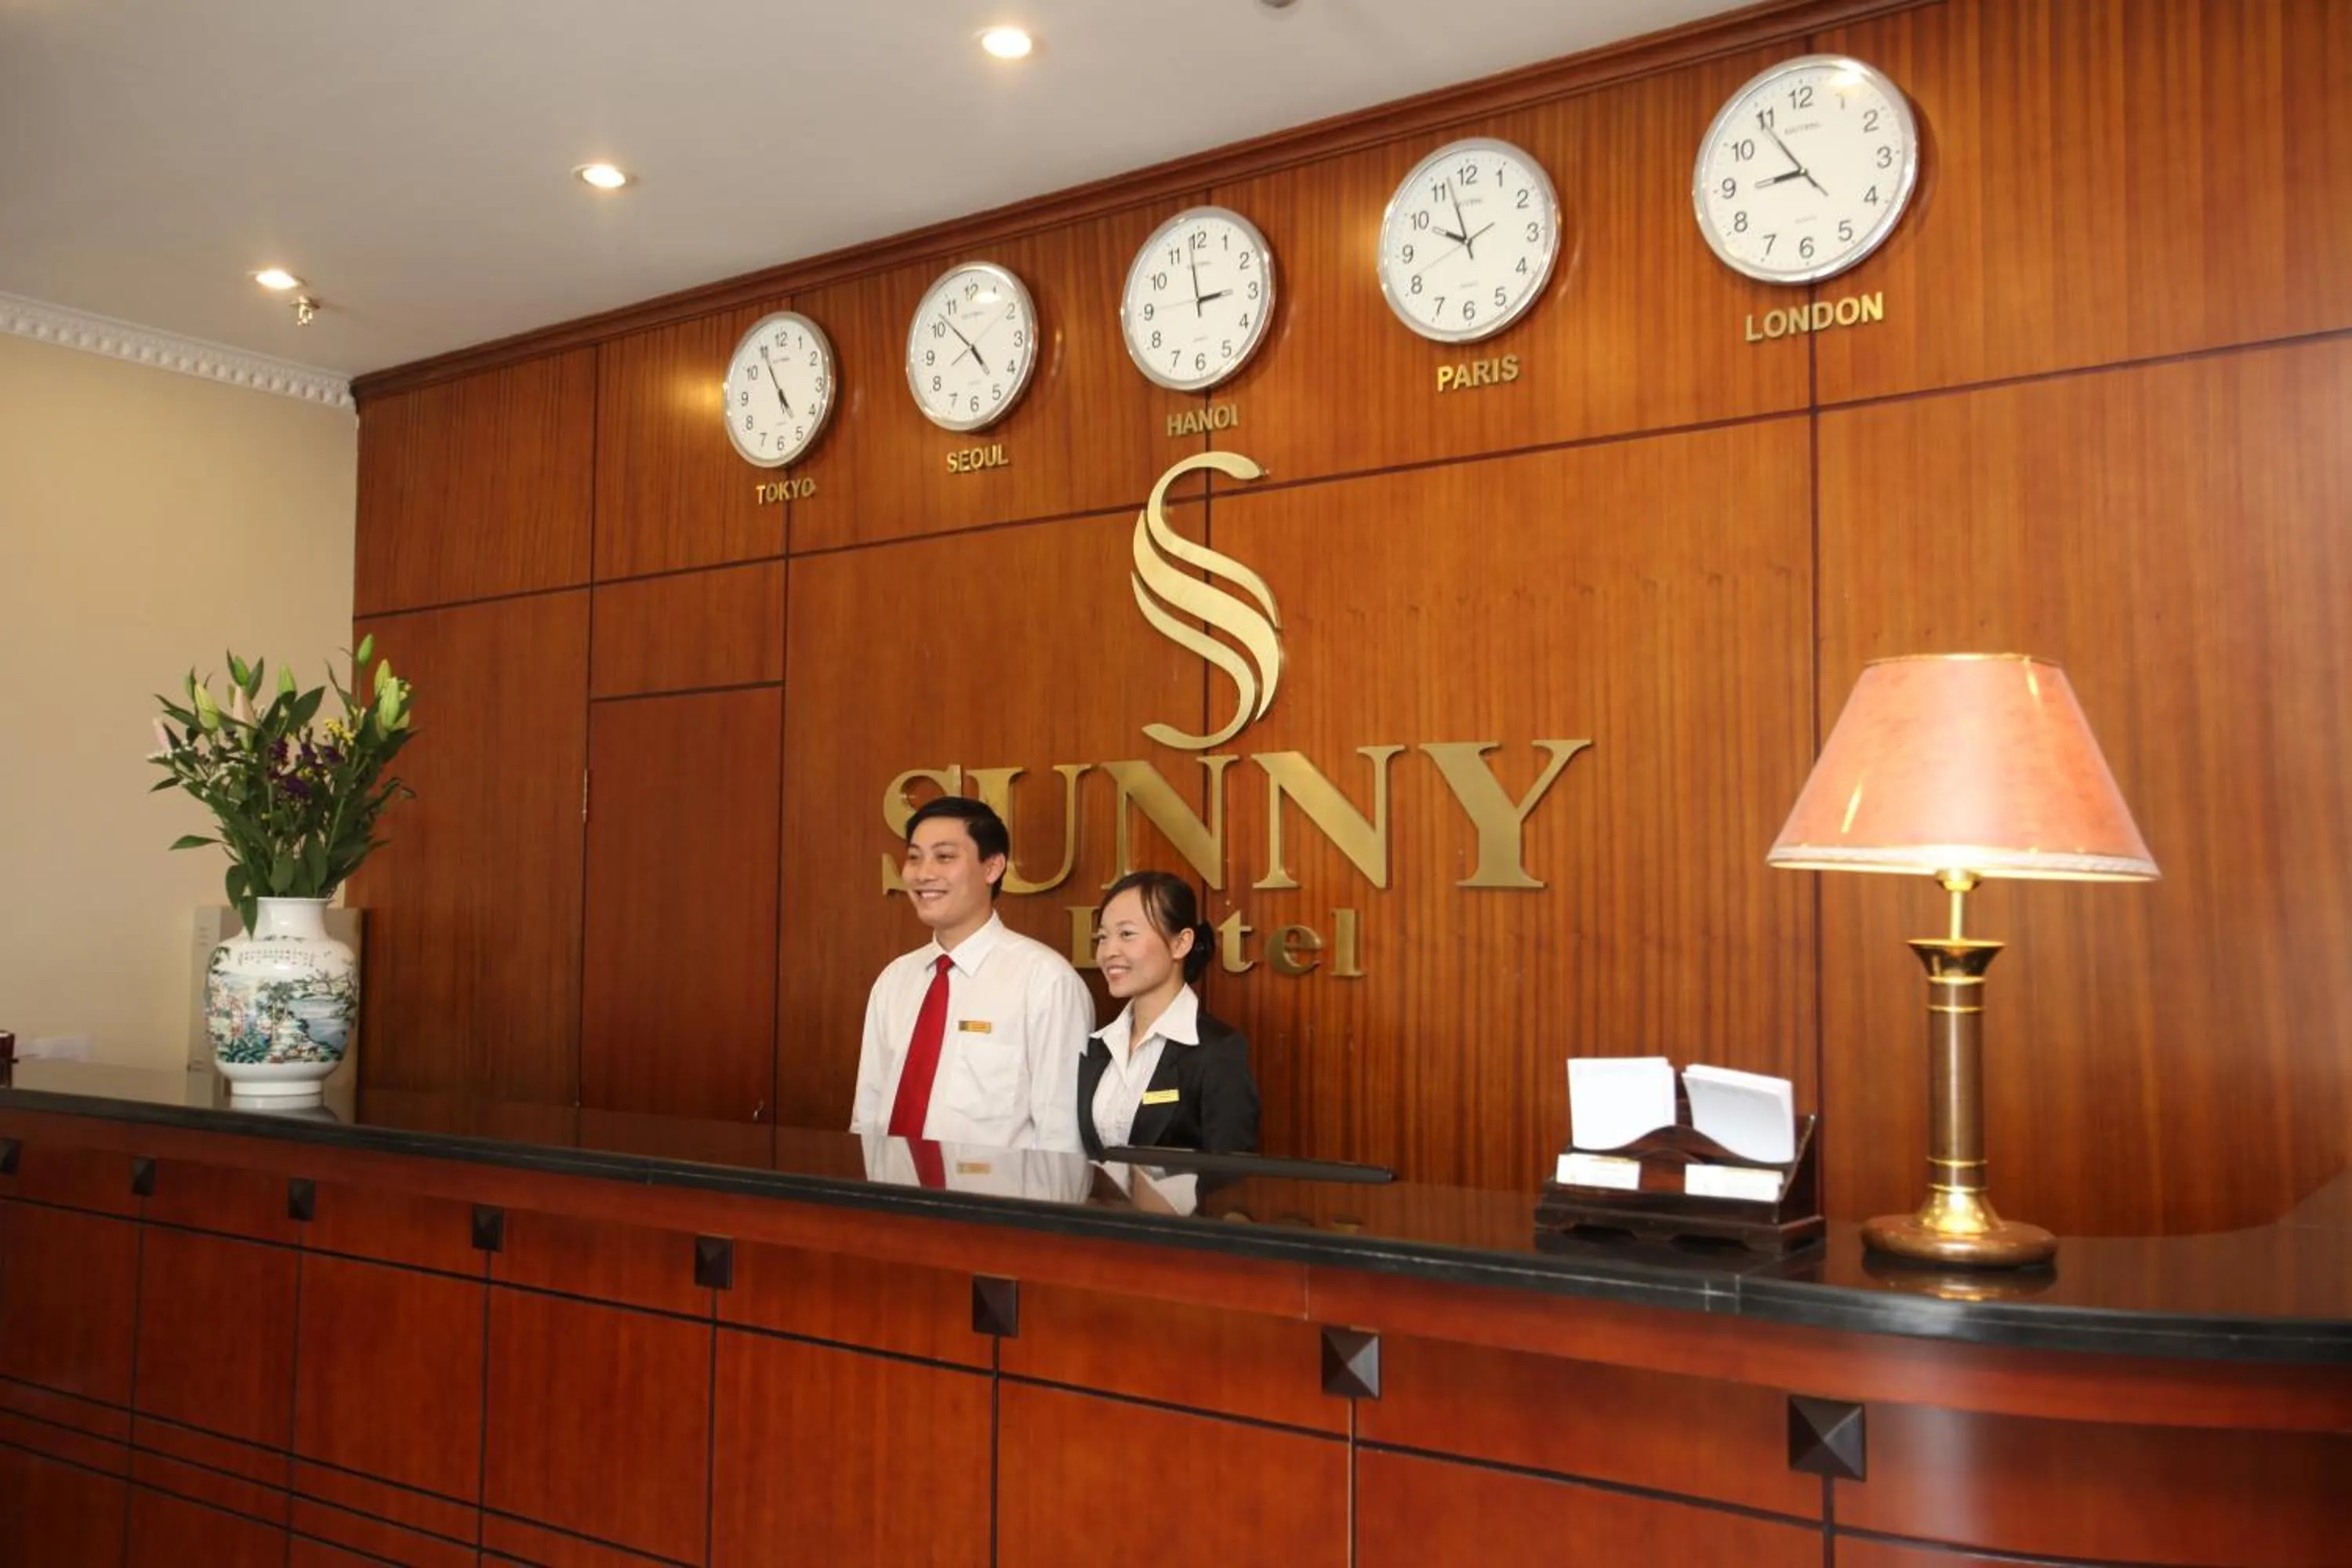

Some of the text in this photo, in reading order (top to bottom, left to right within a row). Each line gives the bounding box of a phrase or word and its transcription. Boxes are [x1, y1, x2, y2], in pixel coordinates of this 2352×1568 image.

[1788, 85, 1813, 110] 12
[1756, 107, 1774, 129] 11
[1864, 110, 1878, 132] 2
[1731, 139, 1755, 162] 10
[1877, 147, 1892, 169] 3
[1457, 165, 1478, 186] 12
[1496, 169, 1503, 187] 1
[1431, 183, 1446, 202] 11
[1722, 178, 1736, 199] 9
[1864, 186, 1878, 206] 4
[1517, 189, 1529, 209] 2
[1411, 211, 1429, 230] 10
[1733, 211, 1748, 233] 8
[1192, 230, 1207, 249] 12
[1527, 222, 1538, 242] 3
[1838, 220, 1853, 241] 5
[1222, 235, 1228, 251] 1
[1764, 234, 1777, 256] 7
[1799, 236, 1814, 259] 6
[1168, 248, 1181, 265] 11
[1240, 252, 1250, 270] 2
[1403, 245, 1414, 263] 9
[1515, 257, 1527, 274] 4
[1151, 273, 1167, 291] 10
[1248, 281, 1258, 299] 3
[1411, 275, 1422, 295] 8
[1435, 297, 1445, 315] 7
[1495, 287, 1506, 307] 5
[946, 299, 956, 315] 11
[1006, 303, 1015, 320] 2
[1144, 304, 1154, 321] 9
[1464, 301, 1475, 320] 6
[1239, 314, 1248, 329] 4
[1745, 292, 1883, 342] LONDON
[932, 321, 946, 338] 10
[1014, 330, 1023, 347] 3
[775, 332, 788, 347] 12
[798, 336, 802, 350] 1
[1152, 331, 1161, 348] 8
[926, 350, 935, 365] 9
[1171, 350, 1181, 366] 7
[1222, 340, 1231, 358] 5
[810, 351, 817, 366] 2
[1007, 360, 1015, 374] 4
[1196, 353, 1206, 370] 6
[747, 365, 758, 380] 10
[1437, 354, 1519, 392] PARIS
[815, 377, 822, 392] 3
[933, 376, 941, 391] 8
[993, 383, 1000, 400] 5
[742, 391, 748, 406] 9
[949, 394, 957, 407] 7
[970, 396, 978, 412] 6
[809, 404, 815, 416] 4
[746, 415, 753, 430] 8
[1167, 404, 1239, 436] HANOI
[760, 433, 767, 446] 7
[797, 426, 803, 441] 5
[777, 436, 784, 451] 6
[946, 444, 1009, 473] SEOUL
[756, 477, 816, 505] TOKYO
[882, 739, 1592, 896] SUNNY
[1066, 906, 1365, 977] tel
